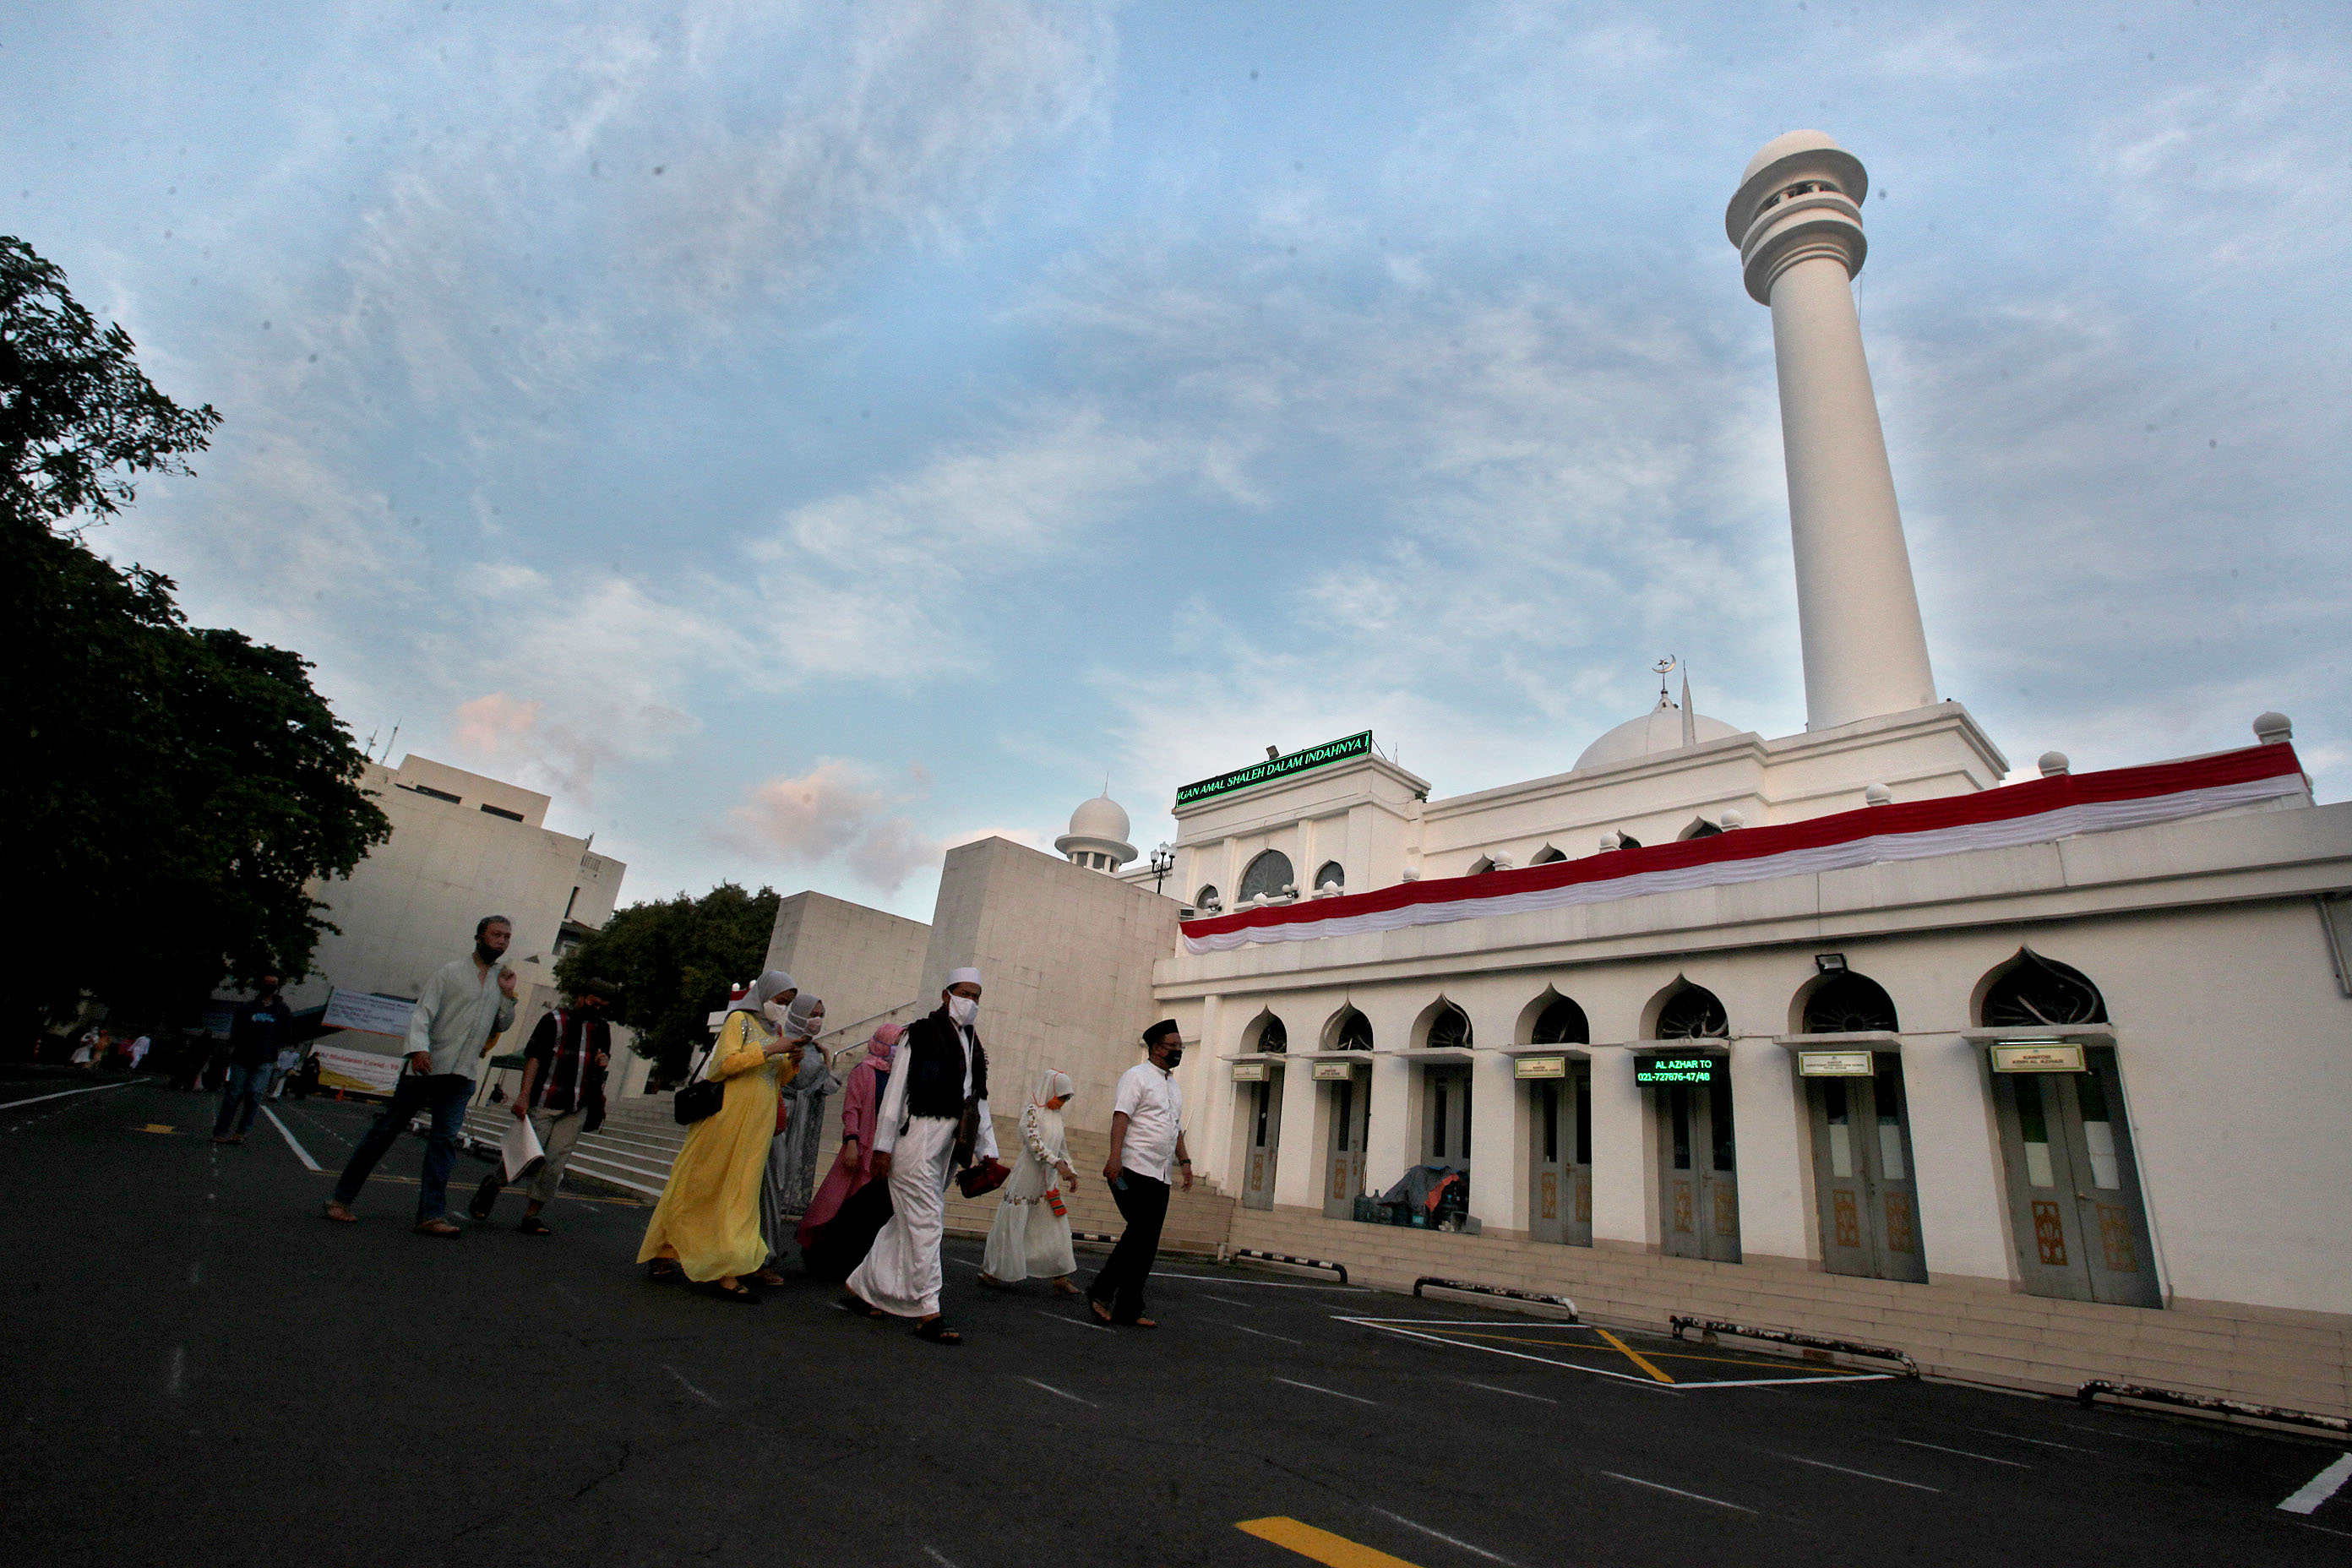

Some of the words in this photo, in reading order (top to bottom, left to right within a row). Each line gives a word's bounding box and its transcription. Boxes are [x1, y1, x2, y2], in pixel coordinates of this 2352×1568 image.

[1200, 780, 1225, 794] AMAL
[1227, 766, 1265, 787] SHALEH
[1266, 754, 1303, 776] DALAM
[1304, 738, 1362, 765] INDAHNYA
[364, 1059, 385, 1069] Covid
[1655, 1060, 1668, 1070] AL
[1668, 1060, 1699, 1069] AZHAR
[1699, 1059, 1712, 1069] TO
